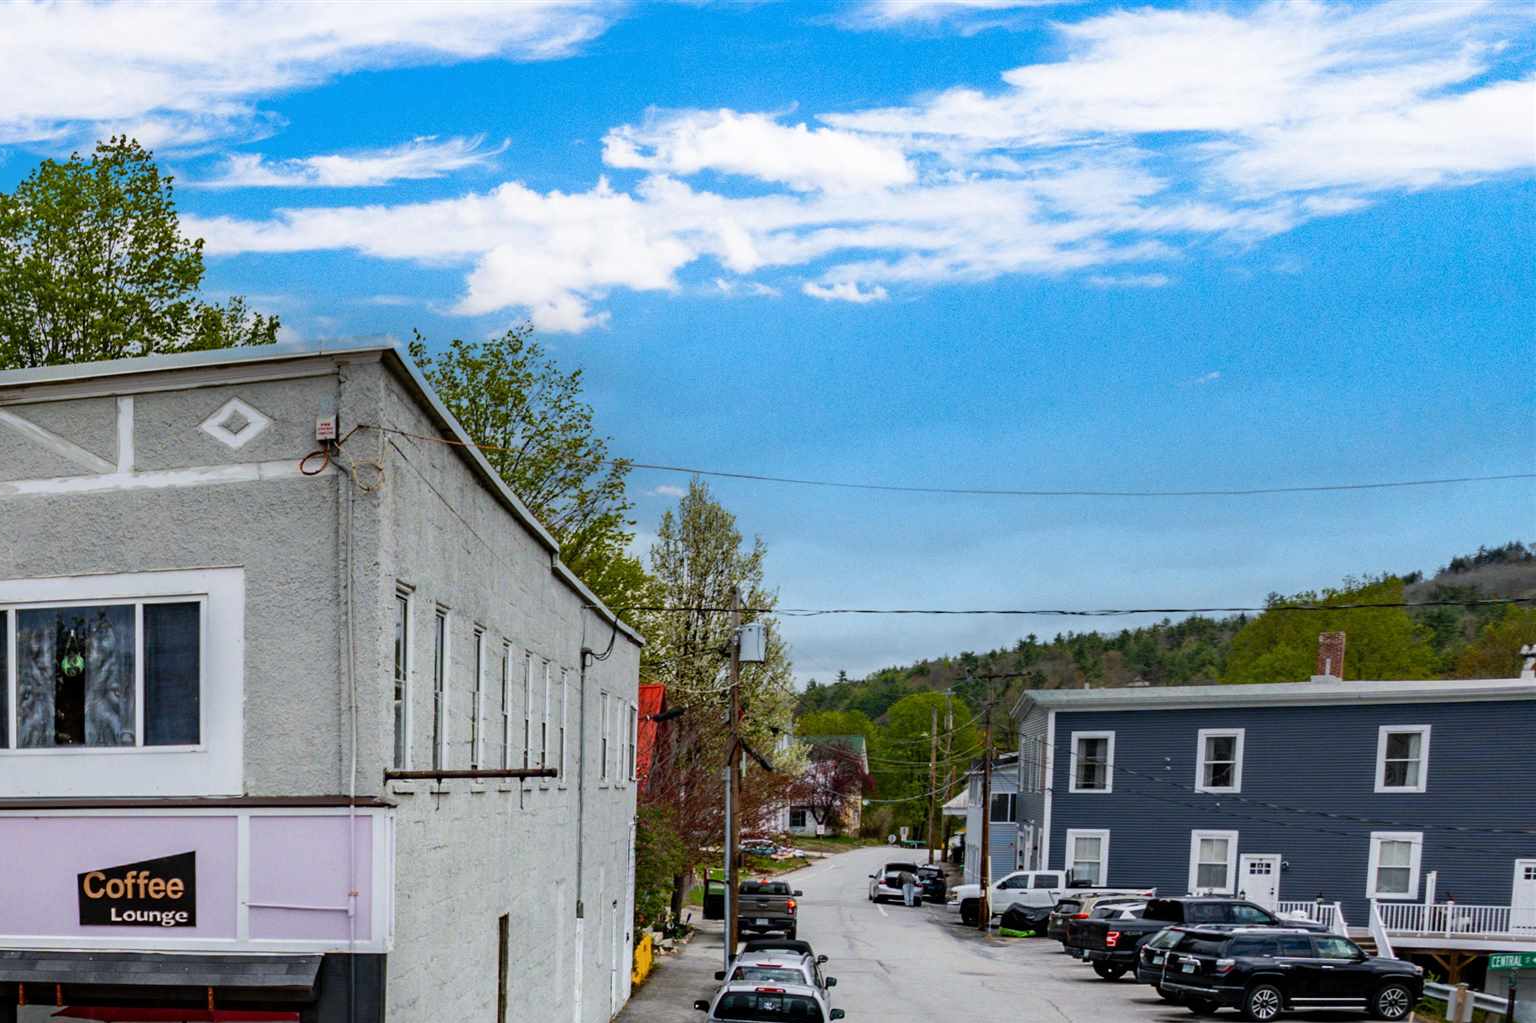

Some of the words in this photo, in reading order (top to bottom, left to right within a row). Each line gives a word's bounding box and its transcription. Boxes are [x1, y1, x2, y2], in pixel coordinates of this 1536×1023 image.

[83, 870, 185, 899] Coffee
[110, 907, 189, 927] Lounge
[1491, 955, 1522, 968] CENTRAL
